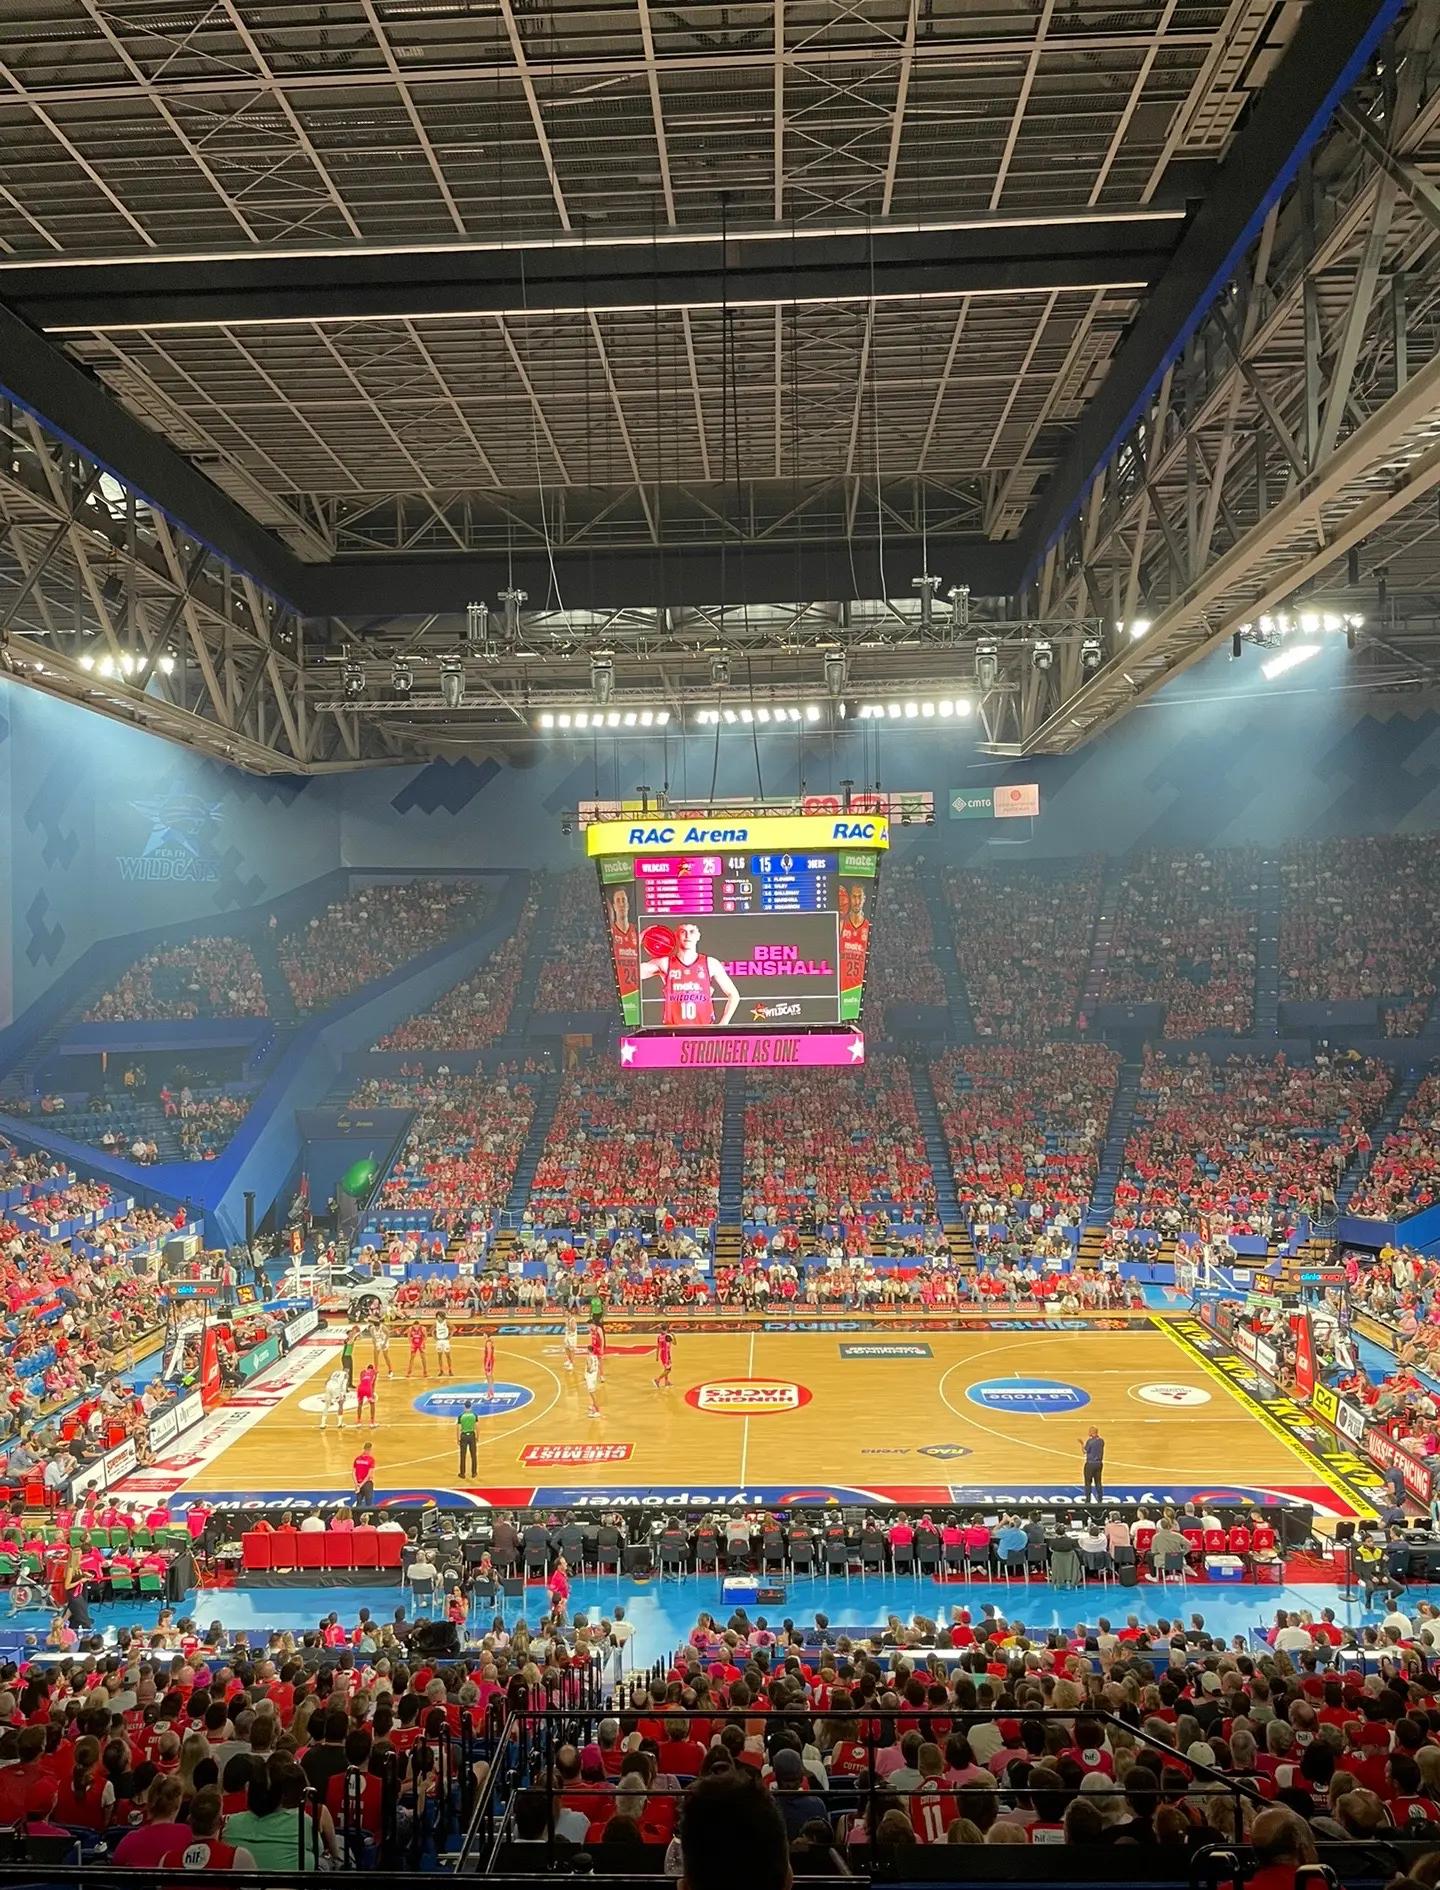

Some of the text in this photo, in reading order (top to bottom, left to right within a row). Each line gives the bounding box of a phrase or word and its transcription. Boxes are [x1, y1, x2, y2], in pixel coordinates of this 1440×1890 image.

[967, 799, 992, 808] CMTG
[629, 827, 748, 844] RAC Arena
[833, 823, 876, 839] RAC
[116, 857, 218, 881] WILDCATS
[641, 857, 716, 874] WILDCATS 25
[759, 857, 826, 873] 15 36ERS
[754, 945, 799, 961] BEN
[721, 960, 834, 977] HENSHALL
[846, 961, 860, 977] 25
[681, 1001, 697, 1020] 10
[764, 1003, 802, 1018] WILDCATS
[680, 1039, 801, 1064] STRONGER AS ONE
[990, 1320, 1089, 1331] alinta
[1172, 1320, 1212, 1341] TKO
[1213, 1356, 1258, 1379] TKO
[704, 1395, 795, 1403] HUNGRY
[705, 1387, 798, 1397] JACK'S
[986, 1393, 1072, 1402] La Trobe
[1316, 1389, 1332, 1411] C4
[1261, 1398, 1314, 1426] TKO
[525, 1448, 627, 1460] CHEMIST
[927, 1448, 964, 1456] RAC
[1322, 1452, 1385, 1487] TKO
[1393, 1450, 1428, 1497] FENCING
[923, 1805, 944, 1841] 11
